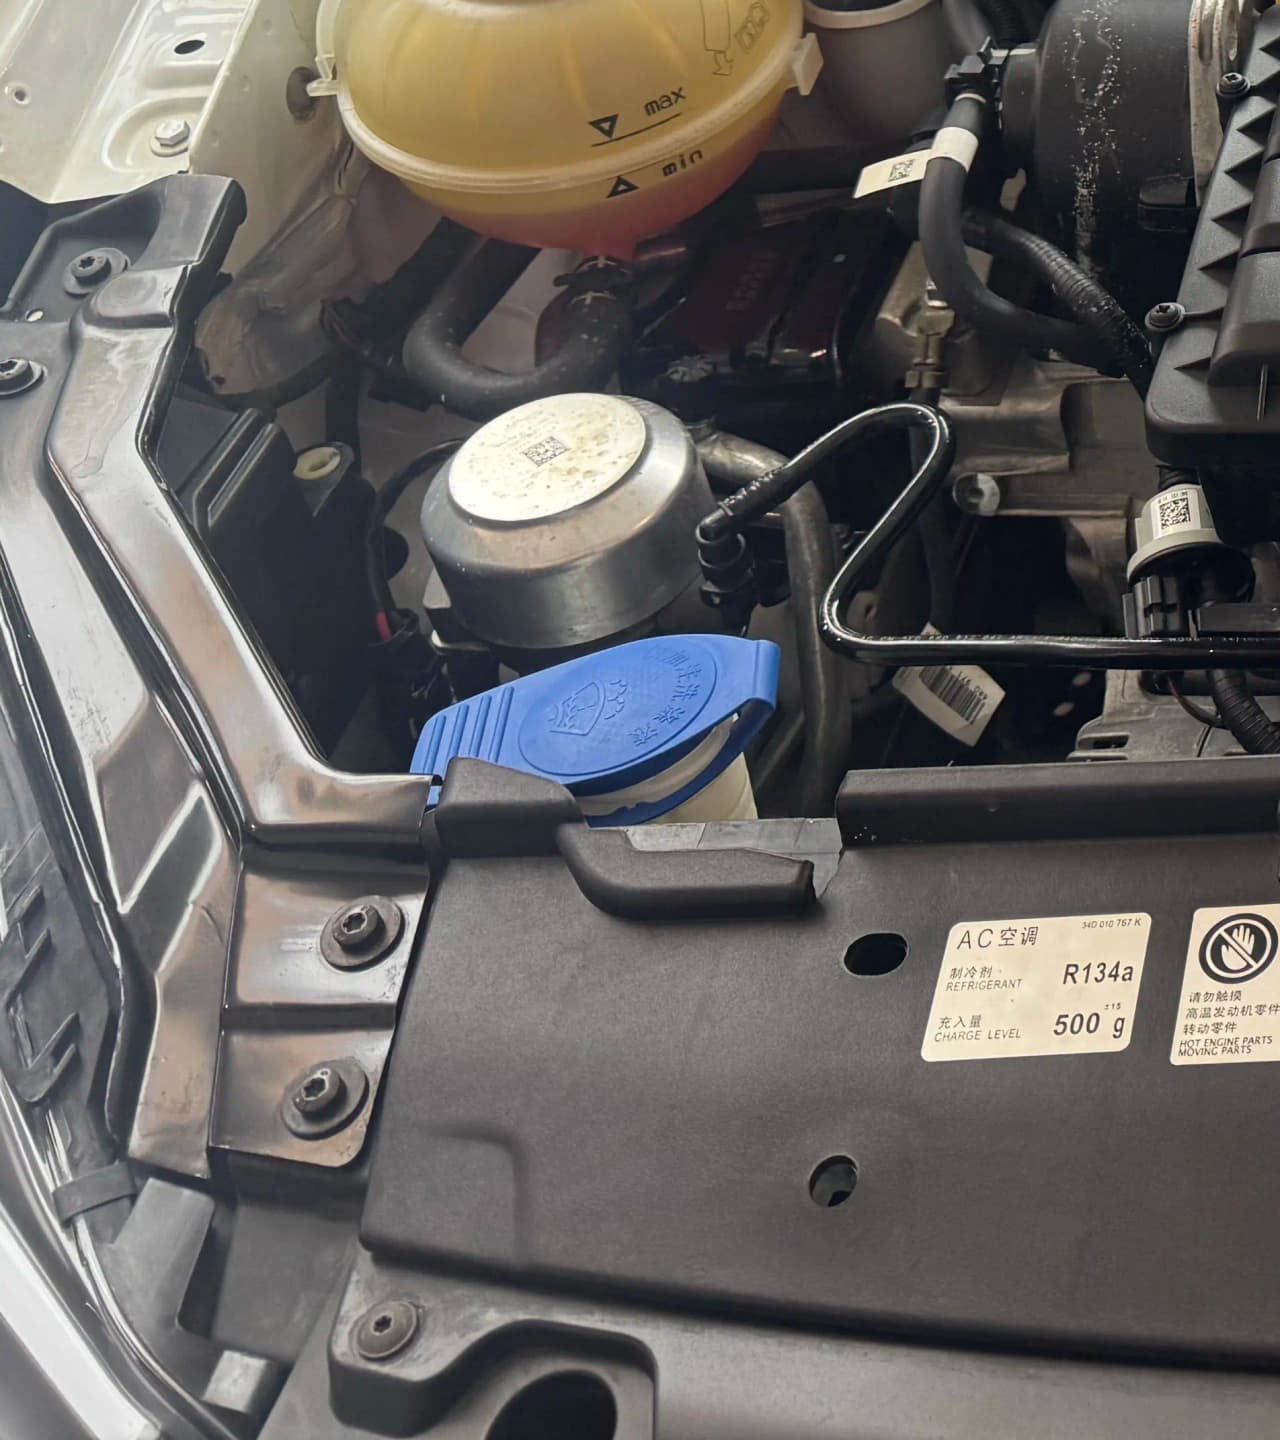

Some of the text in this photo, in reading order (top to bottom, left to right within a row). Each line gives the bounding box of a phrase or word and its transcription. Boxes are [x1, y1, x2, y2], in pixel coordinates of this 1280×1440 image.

[644, 86, 687, 117] max
[661, 147, 704, 177] min
[1099, 920, 1114, 929] 010
[1117, 918, 1132, 928] 767
[1134, 917, 1142, 927] K
[948, 965, 993, 979] 制冷剂
[1063, 961, 1134, 985] R134a
[945, 978, 1023, 992] REFRIGERANT
[1188, 990, 1243, 1004] 请勿触摸
[938, 1015, 982, 1030] 充入量
[1053, 1012, 1126, 1039] 500 g
[1183, 1021, 1238, 1036] 转动零件
[934, 1028, 1022, 1043] CHARGE LEVEL
[1179, 1035, 1273, 1048] HOT ENGINE PARTS
[1178, 1044, 1253, 1057] MOVING PARTS
